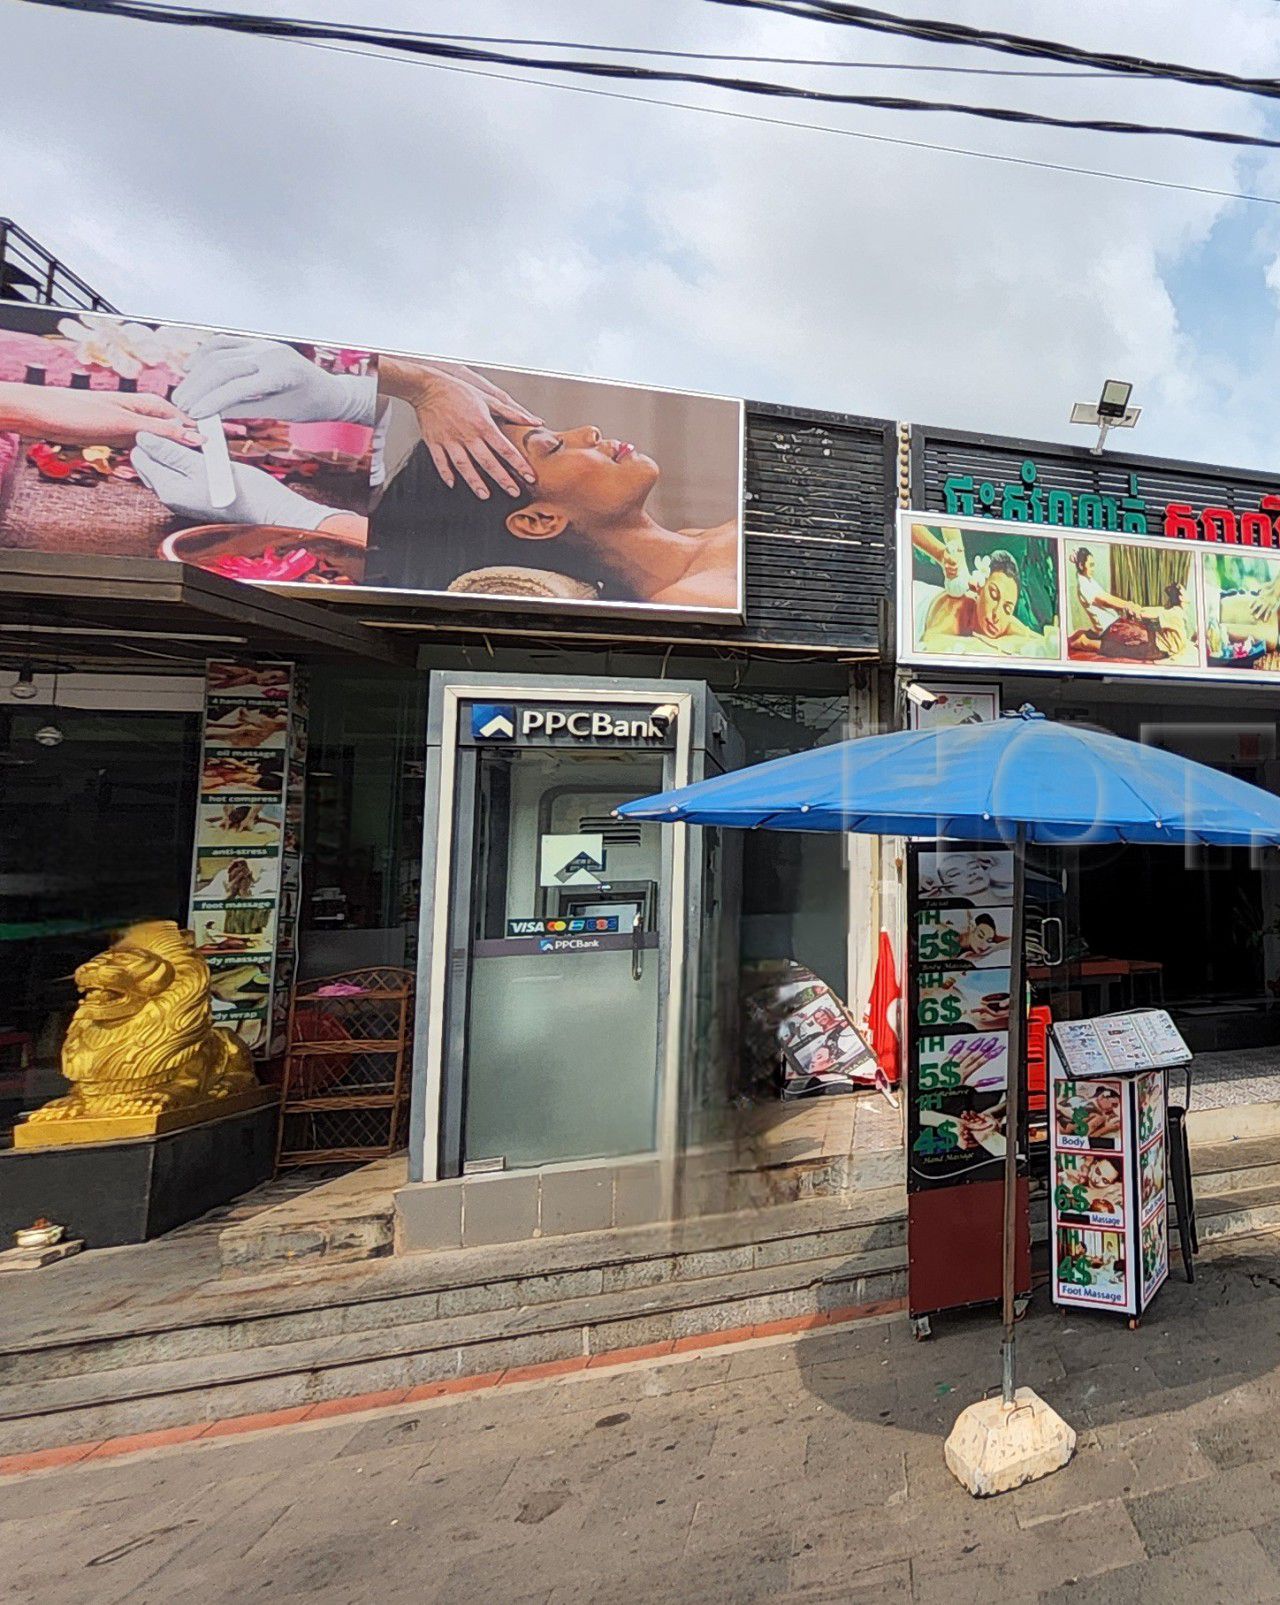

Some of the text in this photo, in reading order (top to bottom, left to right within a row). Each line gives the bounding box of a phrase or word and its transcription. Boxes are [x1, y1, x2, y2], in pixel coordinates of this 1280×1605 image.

[522, 710, 664, 738] PPCBank
[209, 795, 278, 805] hot compress
[211, 848, 268, 857] anti-stress
[201, 901, 271, 910] foot massage
[510, 922, 545, 932] VISA
[555, 938, 600, 950] PPCBank
[919, 928, 962, 960] 5$
[225, 955, 271, 965] massage
[918, 994, 962, 1024] 6$
[919, 1058, 962, 1088] 5$
[1062, 1136, 1085, 1147] Body
[1055, 1184, 1091, 1213] 6$
[1092, 1214, 1120, 1226] Massage
[1058, 1254, 1092, 1286] 4$
[1062, 1285, 1121, 1302] Foot Massage
